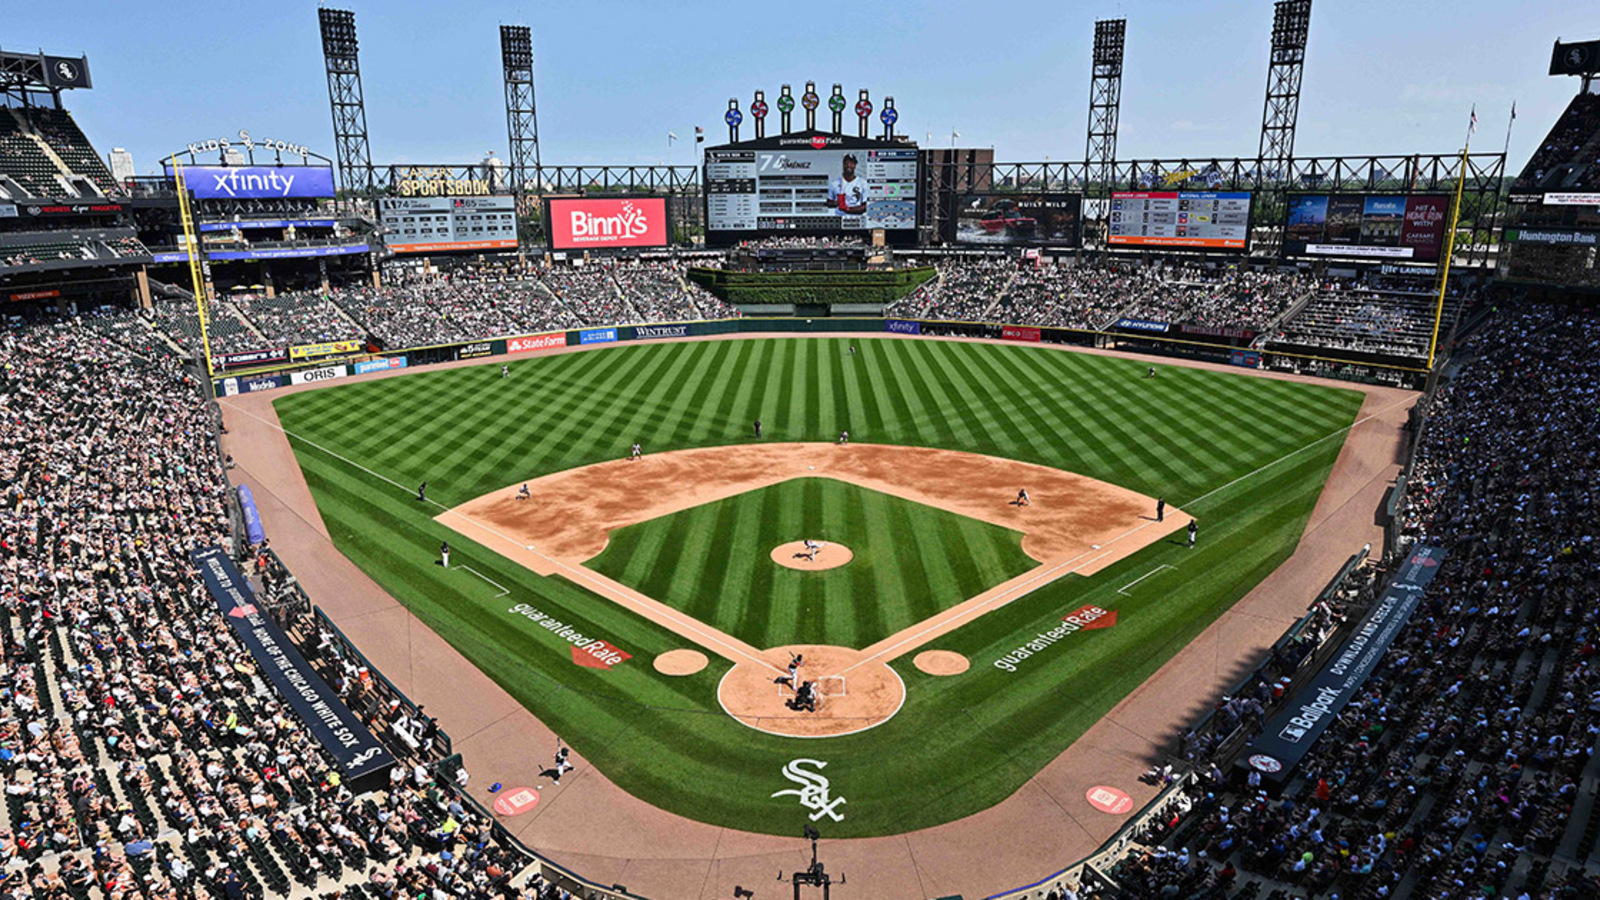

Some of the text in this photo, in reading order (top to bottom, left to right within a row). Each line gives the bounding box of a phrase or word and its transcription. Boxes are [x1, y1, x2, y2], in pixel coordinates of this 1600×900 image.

[187, 137, 230, 155] KIDS
[263, 138, 309, 157] ZONE
[400, 167, 454, 178] CAESARS
[213, 168, 296, 197] xfinity
[402, 179, 490, 196] SPORTSBOOK
[1518, 230, 1597, 244] Huntington Bank
[1400, 267, 1437, 275] LANDING
[636, 326, 687, 338] WINTRUST
[889, 321, 915, 332] xfinity
[1132, 321, 1165, 331] HYUNDAI
[522, 335, 565, 350] State Farm
[303, 369, 336, 382] ORIS
[249, 380, 277, 391] Modelo
[507, 602, 622, 666] guaranteed Rate
[993, 606, 1108, 673] guaranteed Rate
[265, 644, 282, 659] OF
[273, 653, 296, 671] THE
[1289, 686, 1343, 730] Ballpark
[1329, 634, 1369, 676] DOWNLOAD
[1359, 621, 1379, 639] AND
[283, 667, 320, 703] CHICAGO
[311, 699, 344, 730] WHITE
[333, 726, 360, 749] SOX
